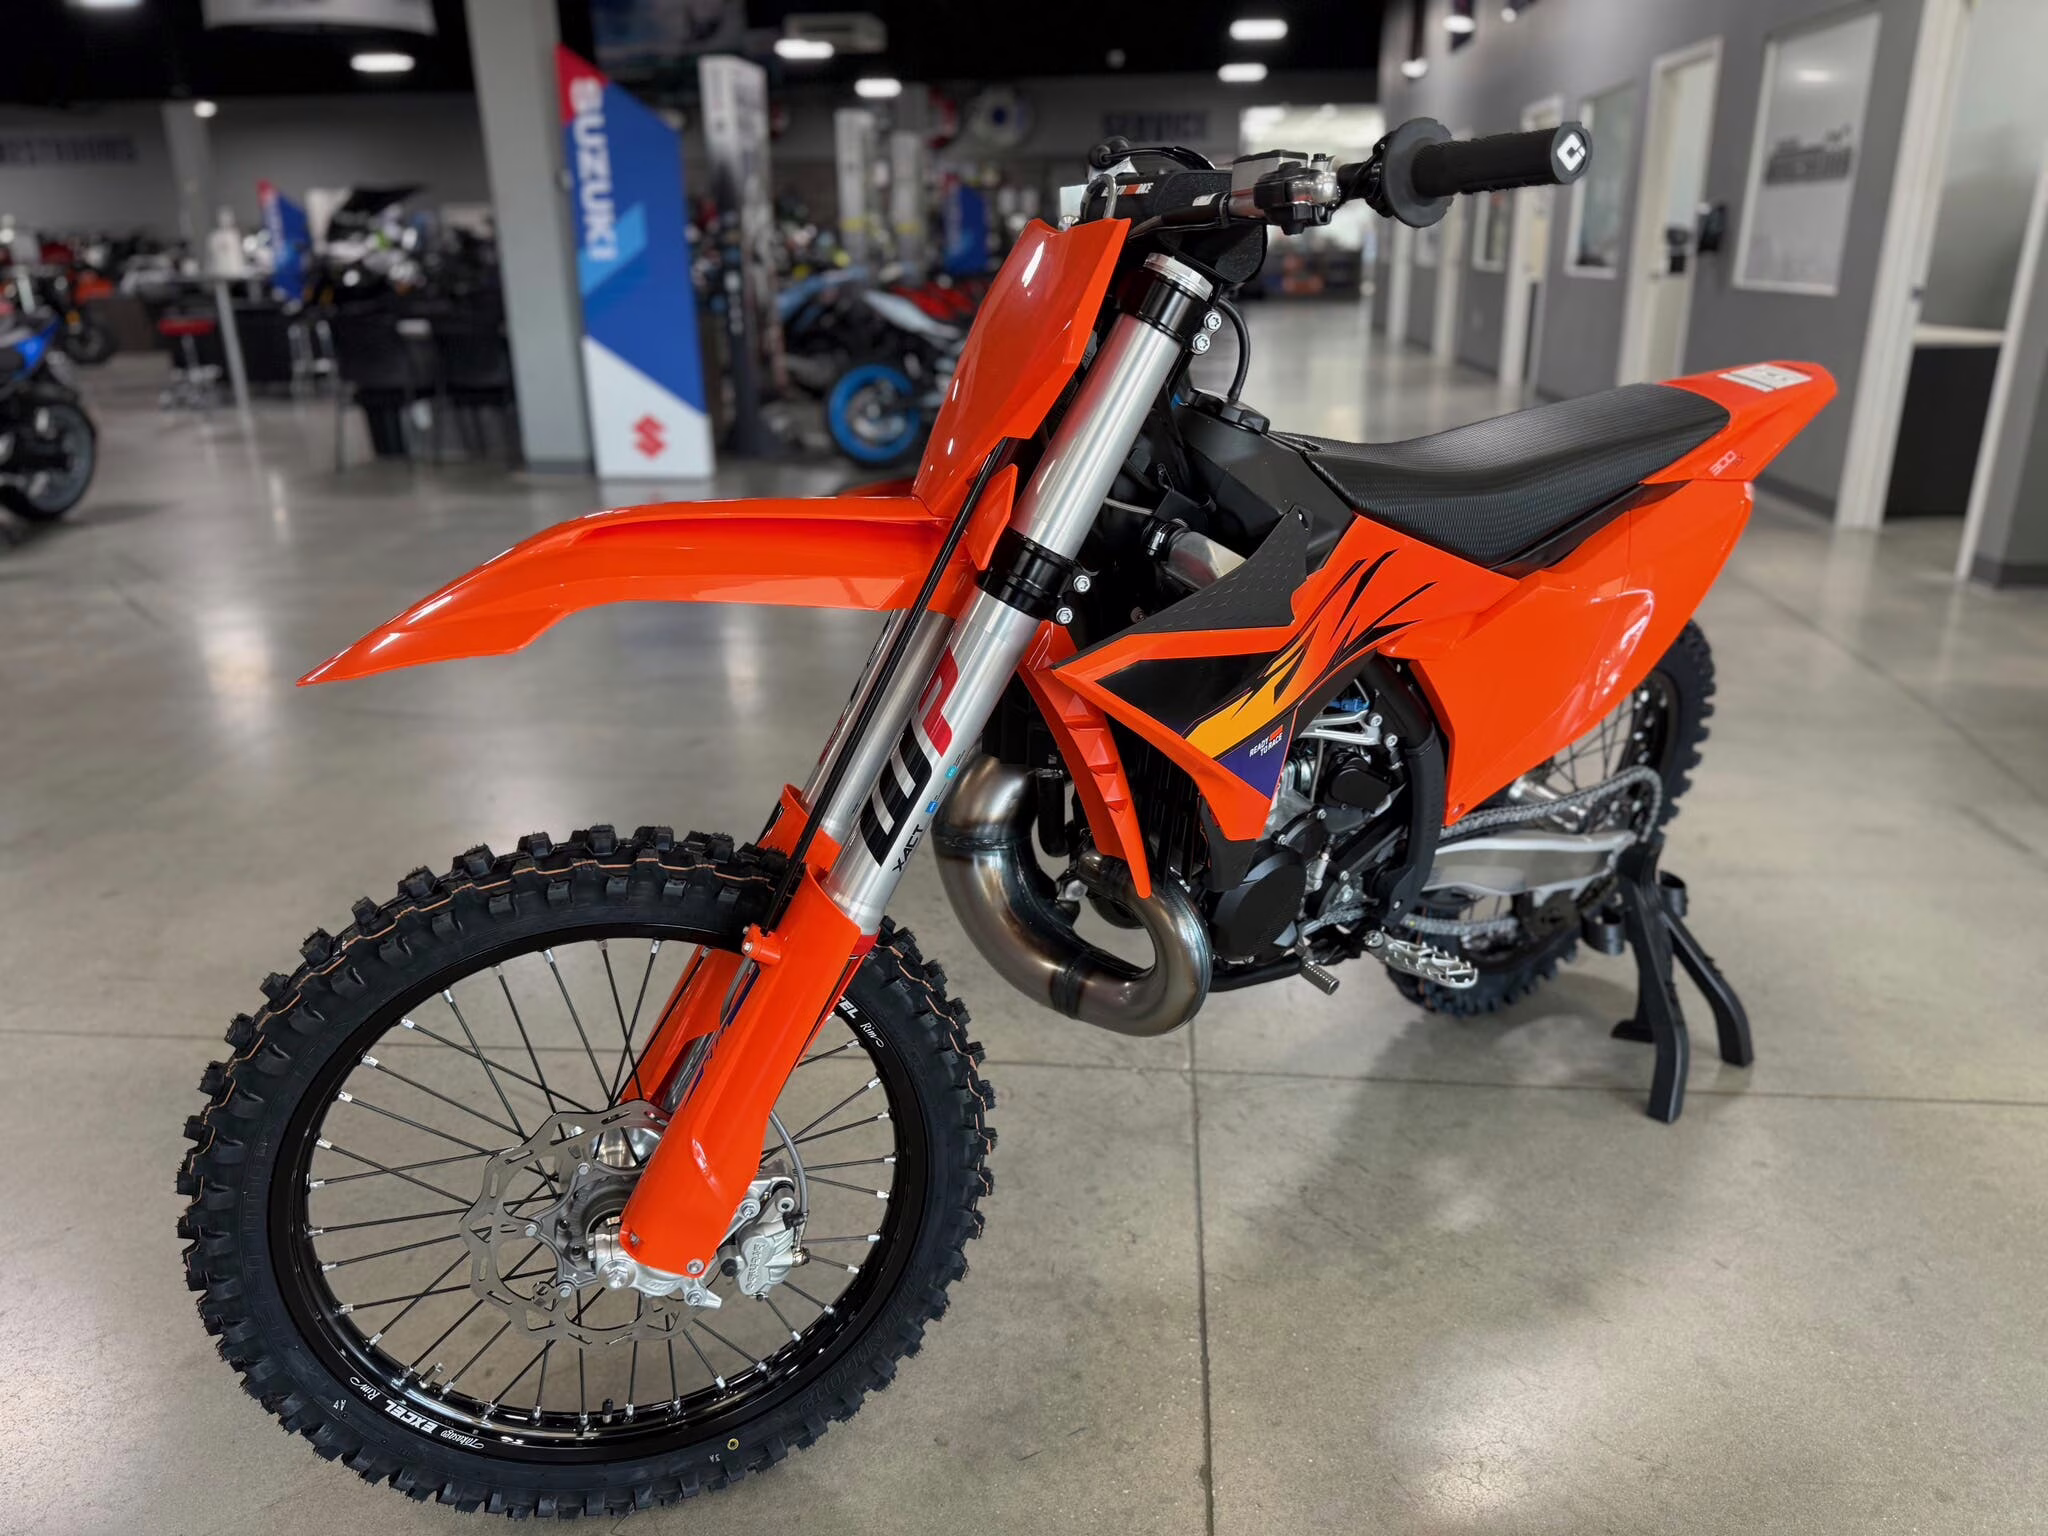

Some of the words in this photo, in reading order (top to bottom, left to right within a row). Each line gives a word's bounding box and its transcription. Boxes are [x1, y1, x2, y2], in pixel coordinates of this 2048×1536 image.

[570, 77, 617, 261] SUZUKI
[1249, 736, 1269, 757] READY
[1268, 732, 1283, 750] RACE
[892, 824, 925, 872] XACT
[839, 996, 858, 1019] EL
[860, 1022, 885, 1048] Rim
[350, 1376, 381, 1400] Rim
[384, 1400, 438, 1434] EXCEL
